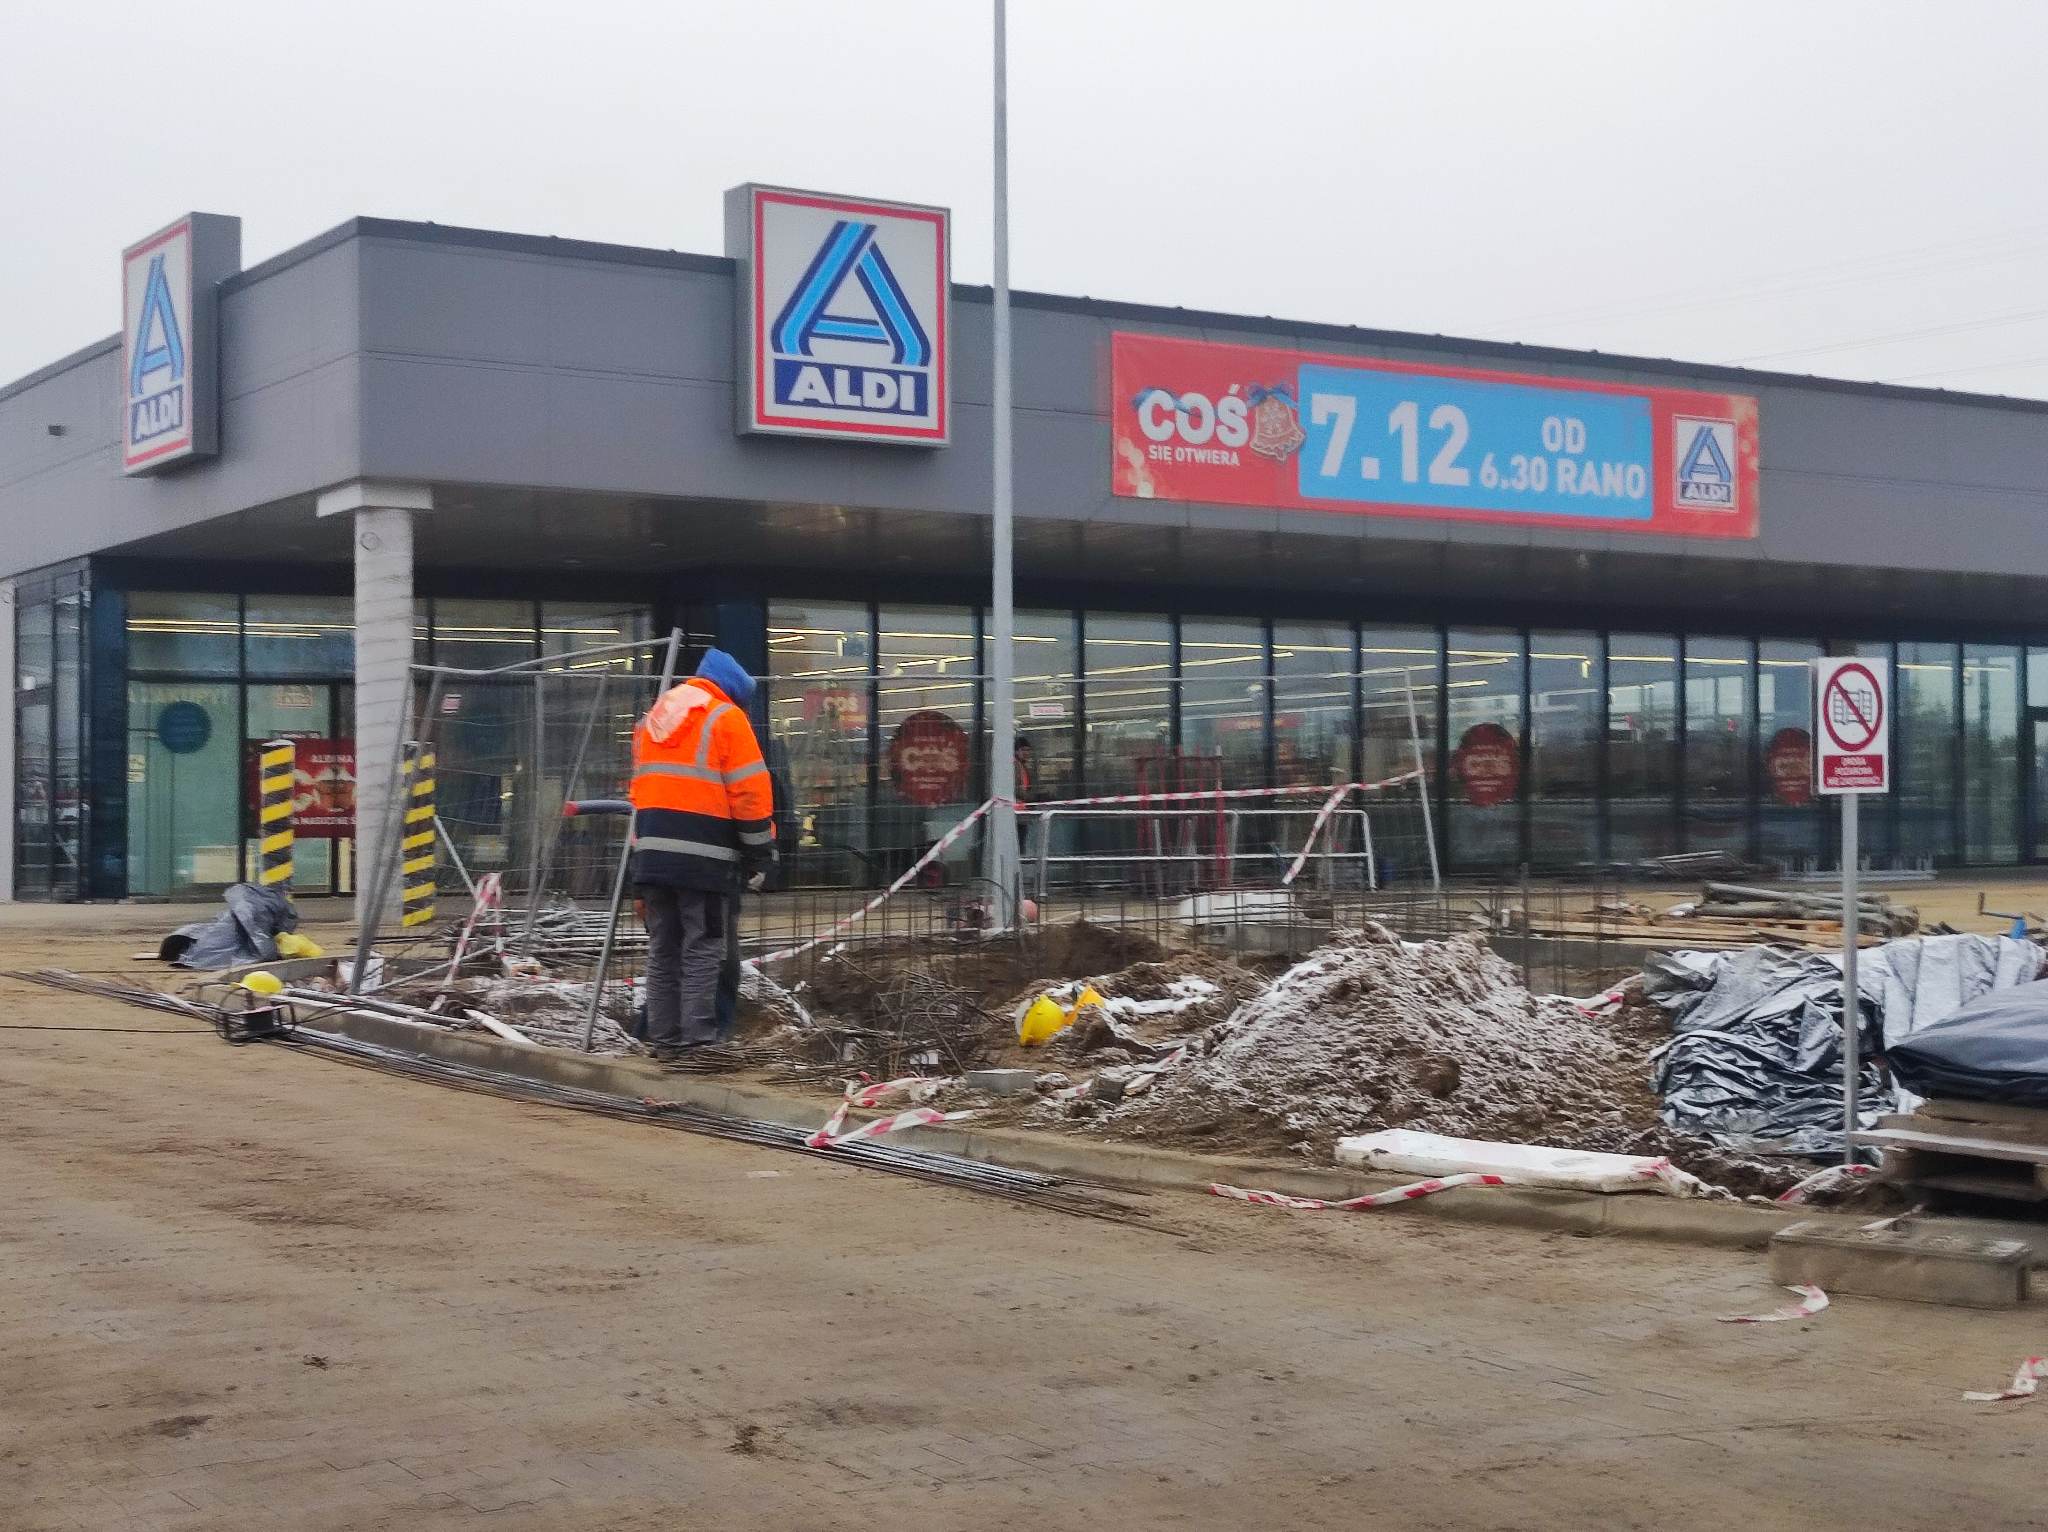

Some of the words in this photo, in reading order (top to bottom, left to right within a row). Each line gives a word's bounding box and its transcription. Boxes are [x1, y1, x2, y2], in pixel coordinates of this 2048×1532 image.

[788, 366, 916, 411] ALDI
[134, 390, 182, 439] ALDI
[1138, 384, 1250, 448] COŚ
[1541, 415, 1587, 454] OD
[1148, 444, 1172, 465] SIĘ
[1175, 446, 1241, 467] OTWIERA
[1311, 392, 1470, 487] 7.12
[1479, 452, 1549, 492] 6.30
[1556, 458, 1647, 499] RANO
[1685, 481, 1729, 501] ALDI
